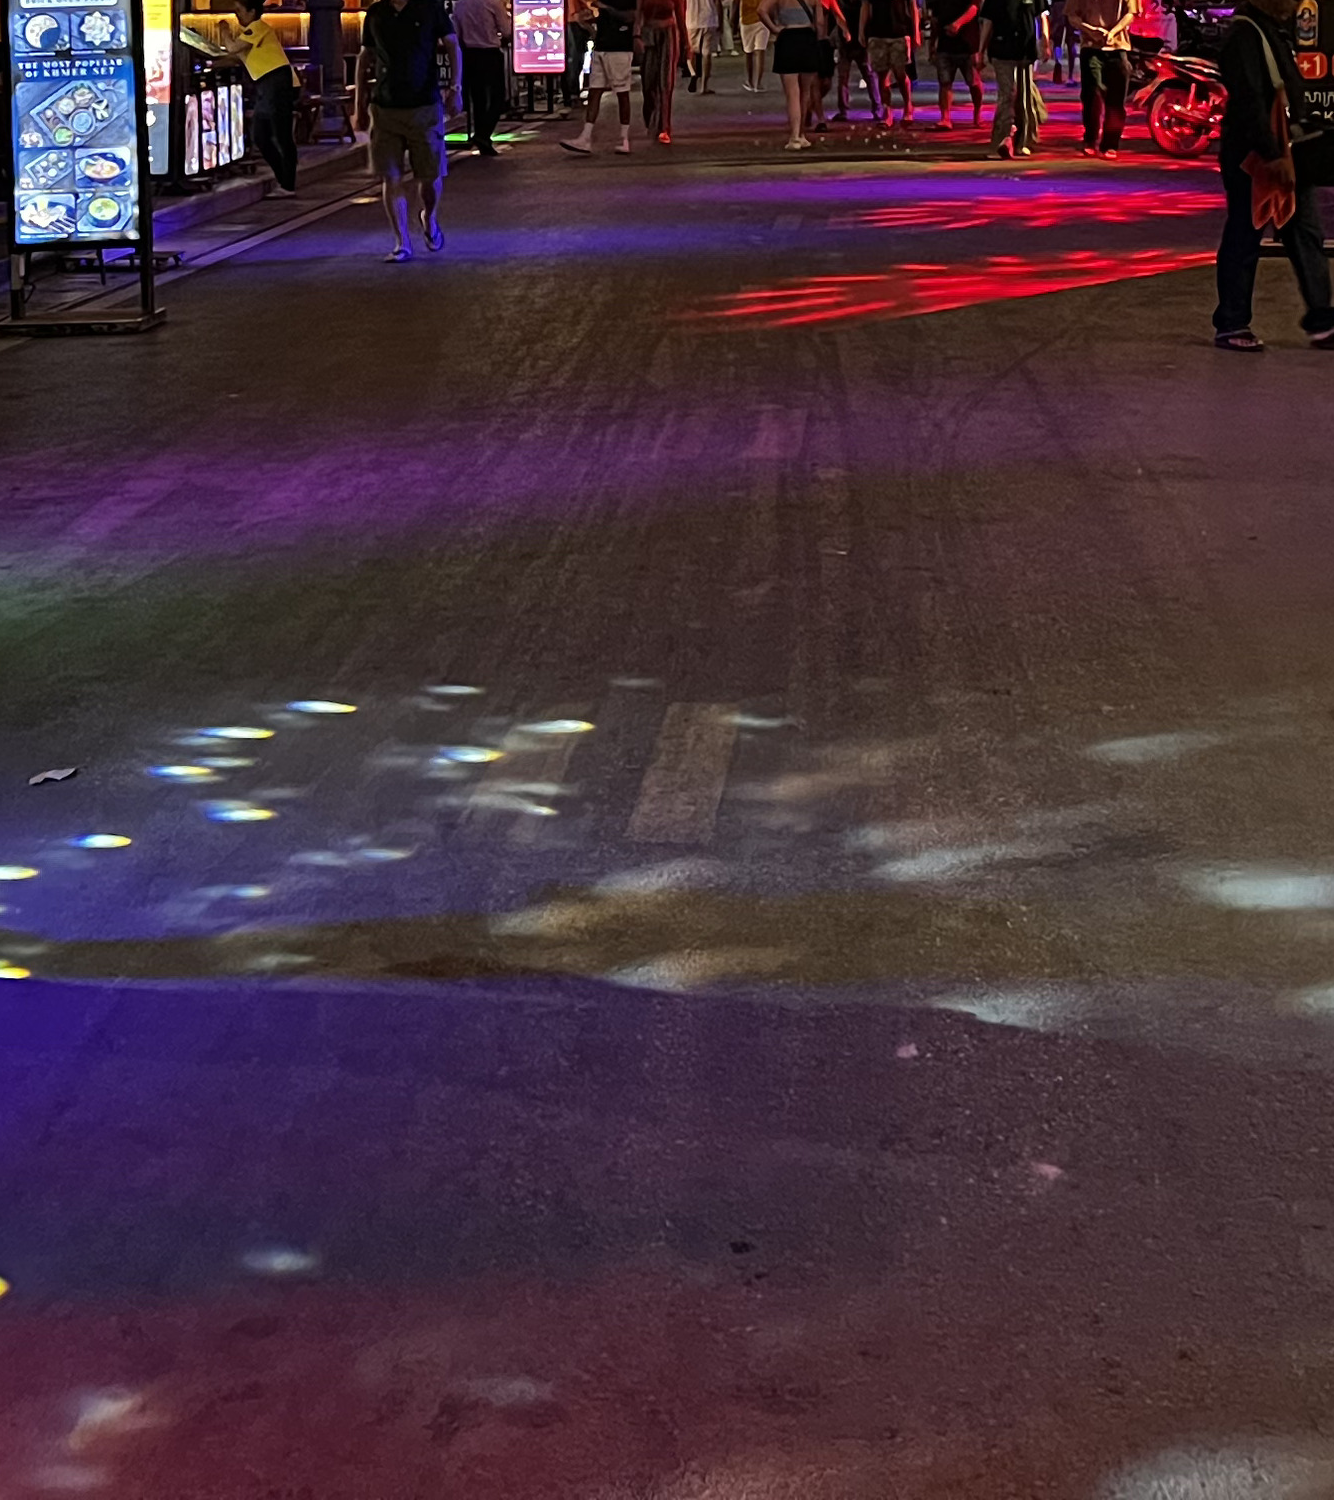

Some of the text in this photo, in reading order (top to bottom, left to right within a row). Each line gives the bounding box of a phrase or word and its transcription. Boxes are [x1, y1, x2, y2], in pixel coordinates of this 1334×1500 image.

[18, 58, 124, 71] THE MOST POPULAR
[24, 66, 116, 79] OF KHMER SET
